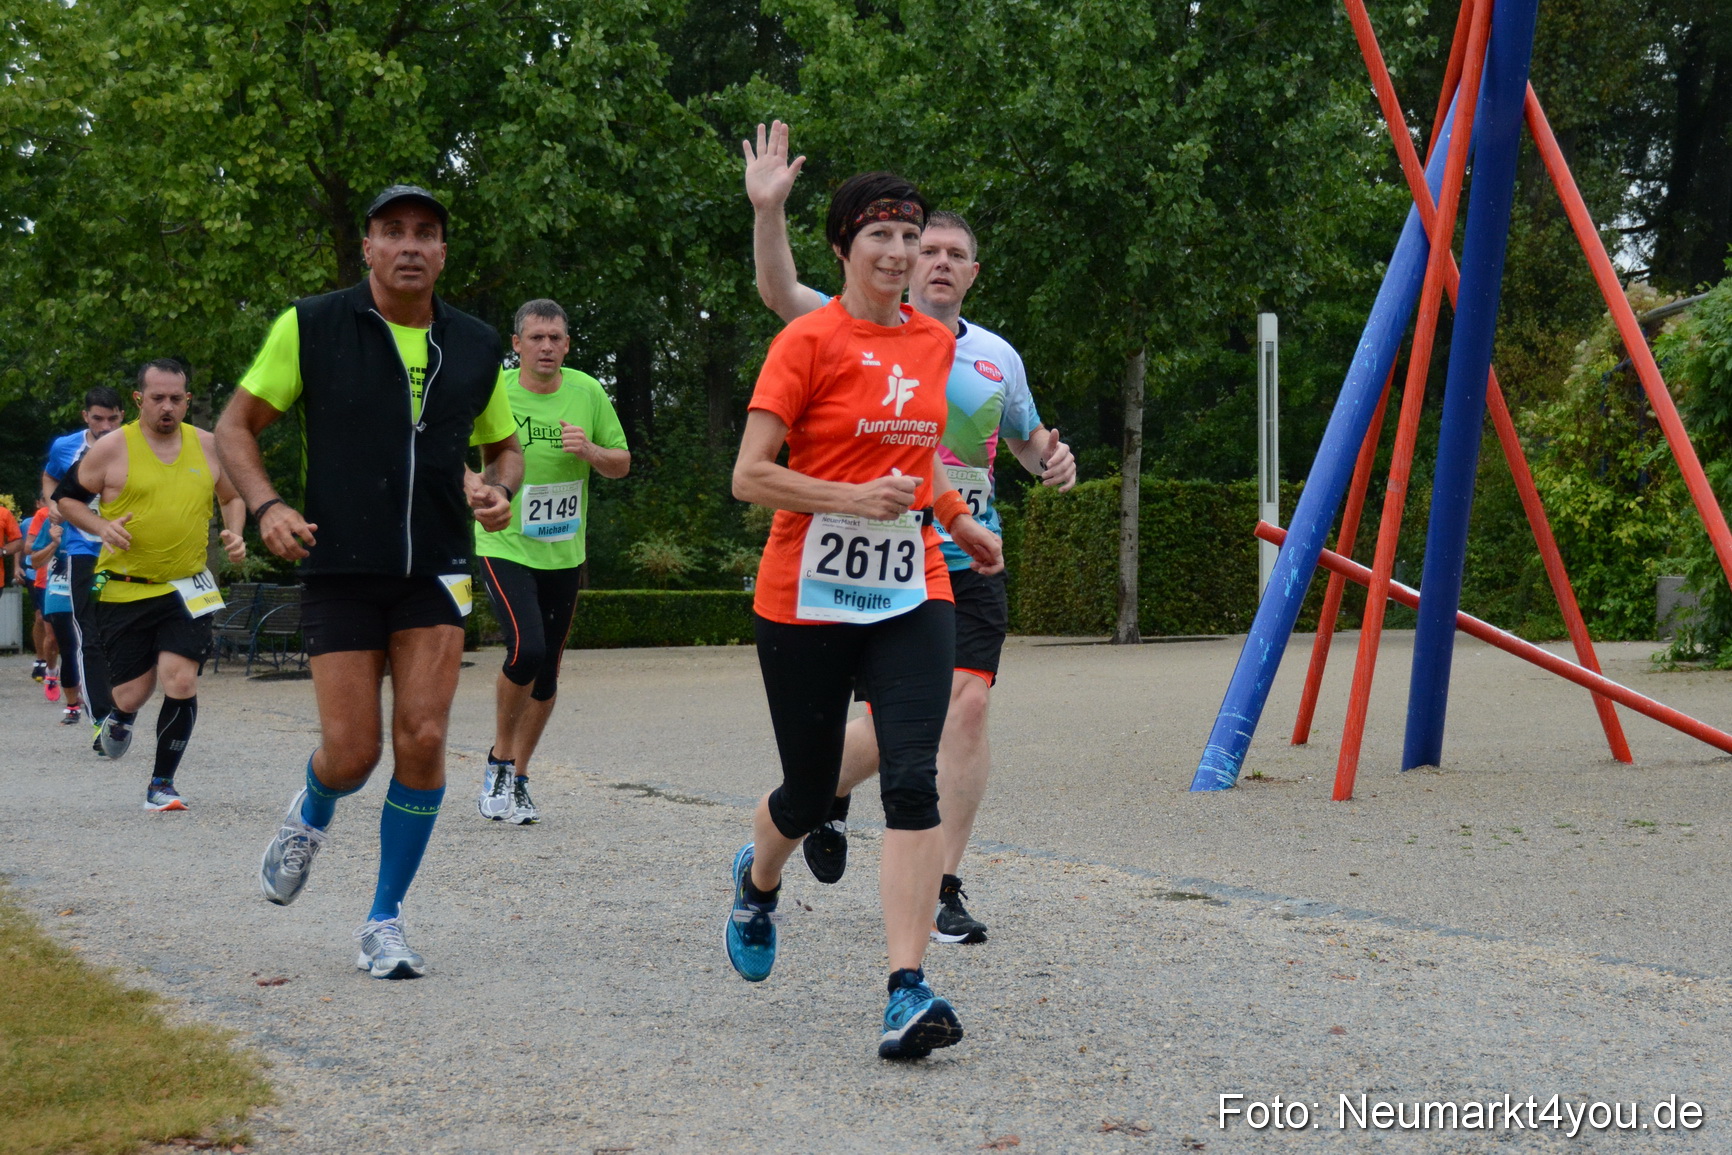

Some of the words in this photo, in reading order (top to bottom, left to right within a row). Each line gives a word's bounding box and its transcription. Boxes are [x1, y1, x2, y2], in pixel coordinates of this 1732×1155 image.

[855, 419, 938, 437] funrunners
[529, 495, 578, 521] 2149
[538, 524, 570, 536] Michael
[821, 516, 861, 527] NeuerMarkt
[816, 532, 916, 583] 2613
[192, 572, 213, 591] 40
[834, 589, 892, 612] Brigitte
